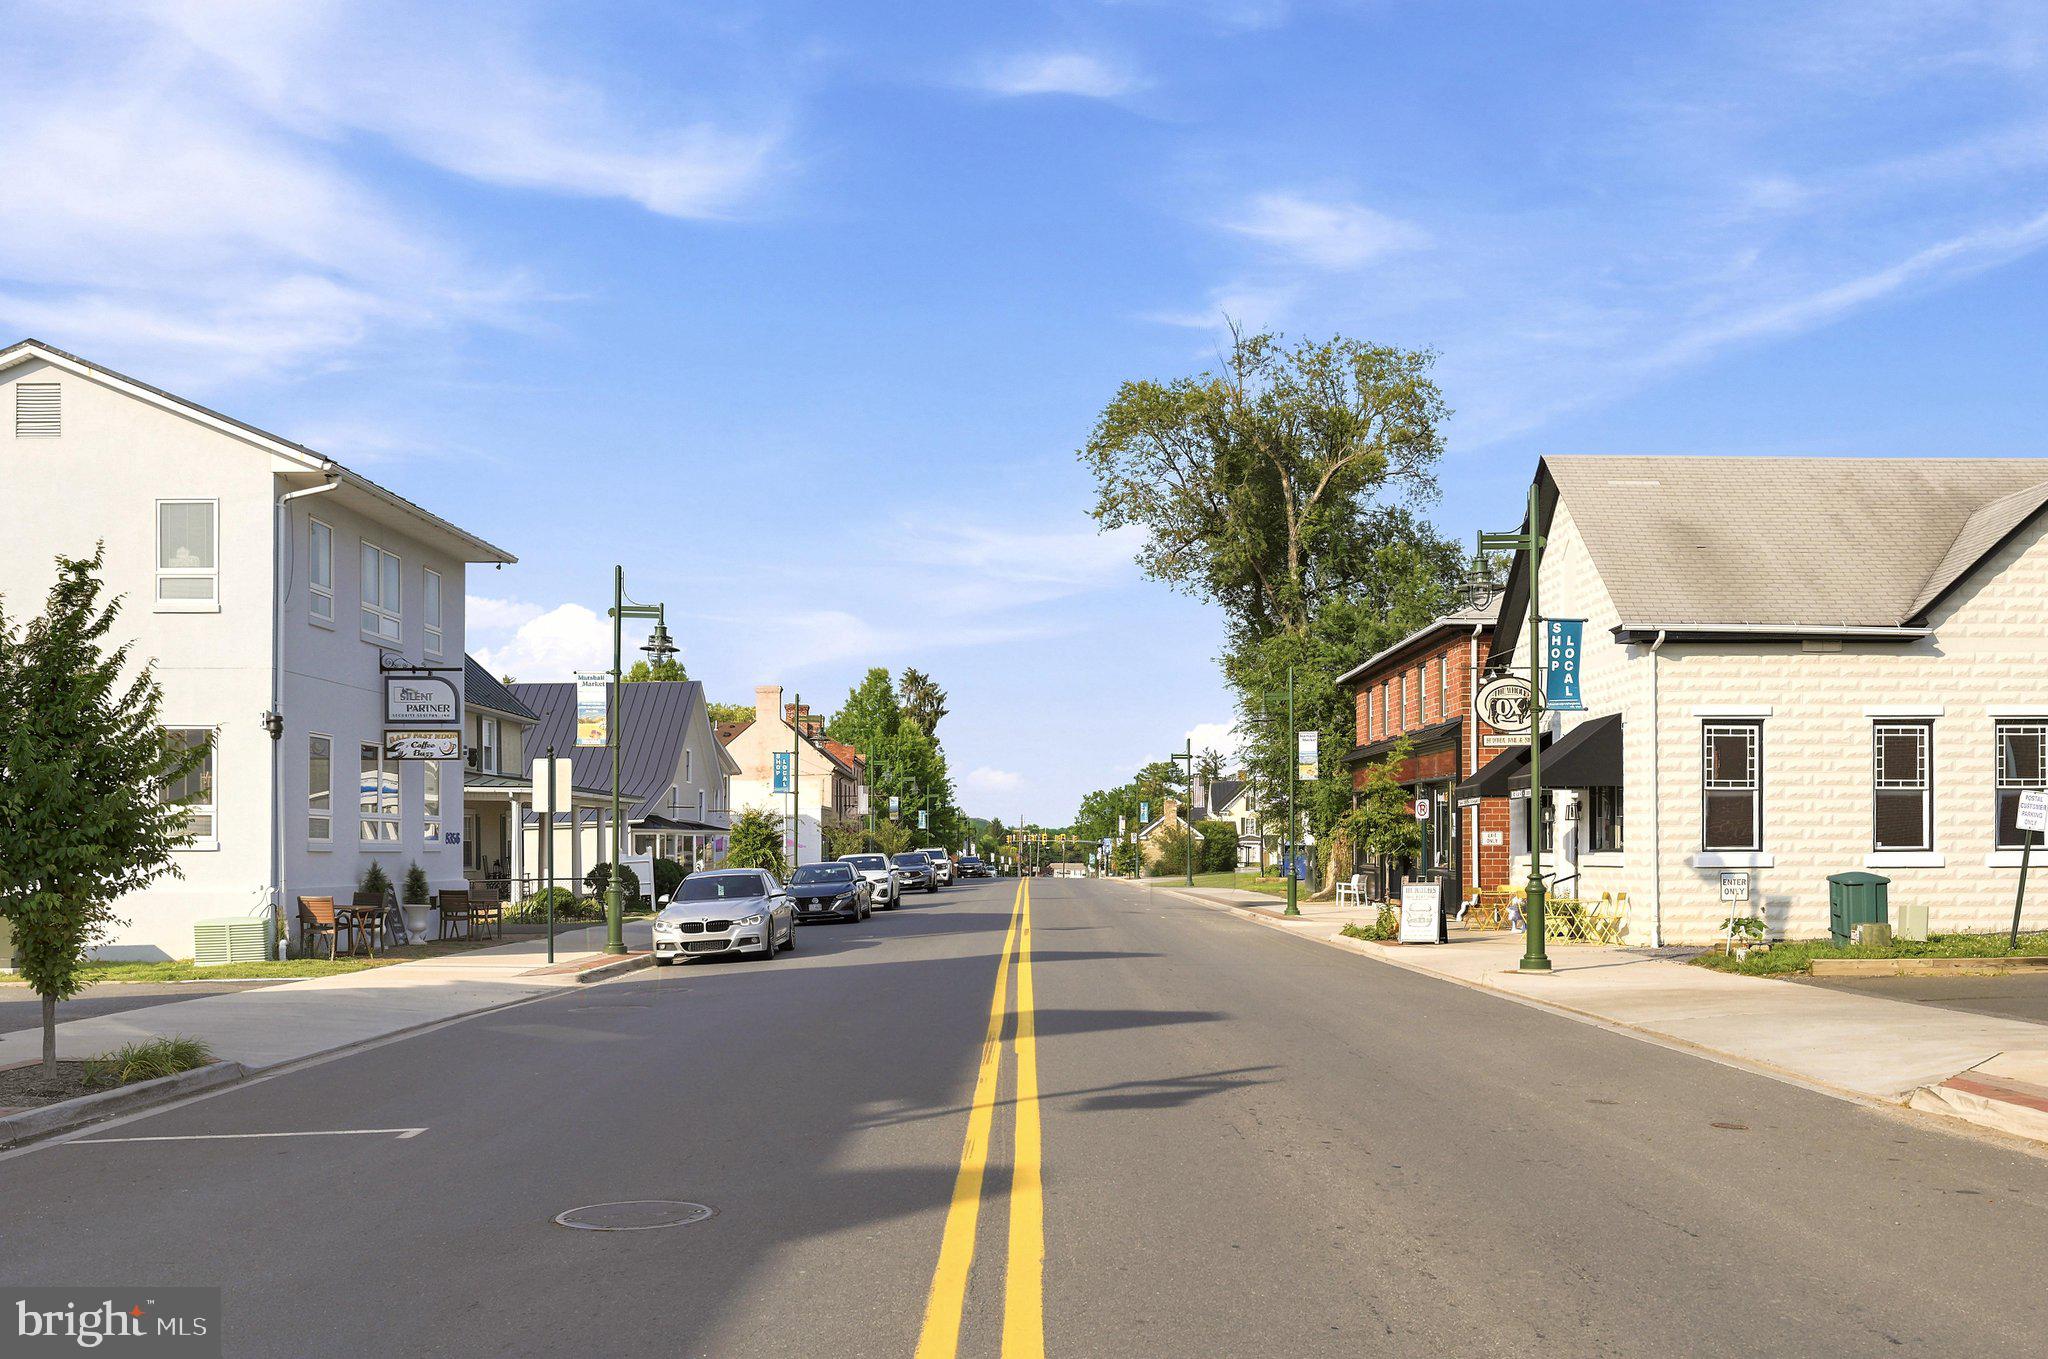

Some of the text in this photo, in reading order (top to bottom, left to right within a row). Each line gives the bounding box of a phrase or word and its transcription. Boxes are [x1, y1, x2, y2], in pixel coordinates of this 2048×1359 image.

[1551, 623, 1562, 671] SHOP
[1564, 635, 1575, 696] LOCAL
[400, 691, 433, 701] SILENT
[406, 704, 450, 712] PARTNER
[1496, 699, 1524, 718] OX
[411, 741, 435, 749] Coffee
[413, 749, 434, 757] Buzz
